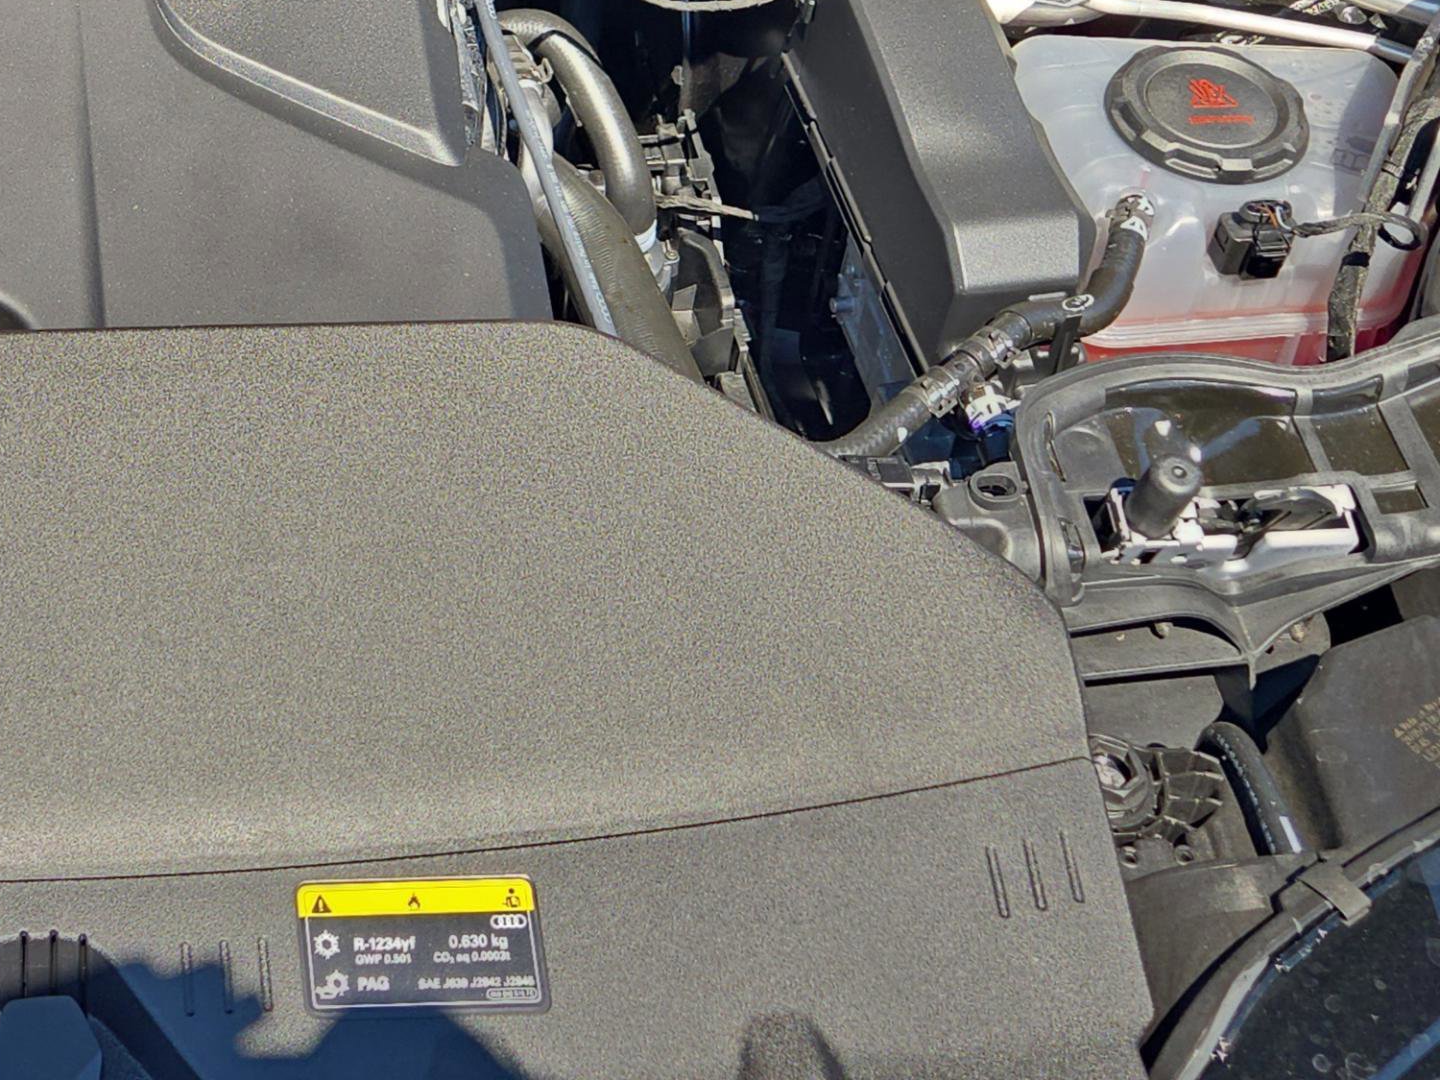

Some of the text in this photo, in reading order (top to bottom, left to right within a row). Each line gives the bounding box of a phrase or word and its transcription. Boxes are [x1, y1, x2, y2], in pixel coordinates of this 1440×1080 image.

[353, 935, 416, 953] R-1234yf
[491, 934, 508, 949] kg
[355, 954, 382, 965] GWP
[357, 976, 390, 991] PAG
[418, 977, 441, 989] SAE
